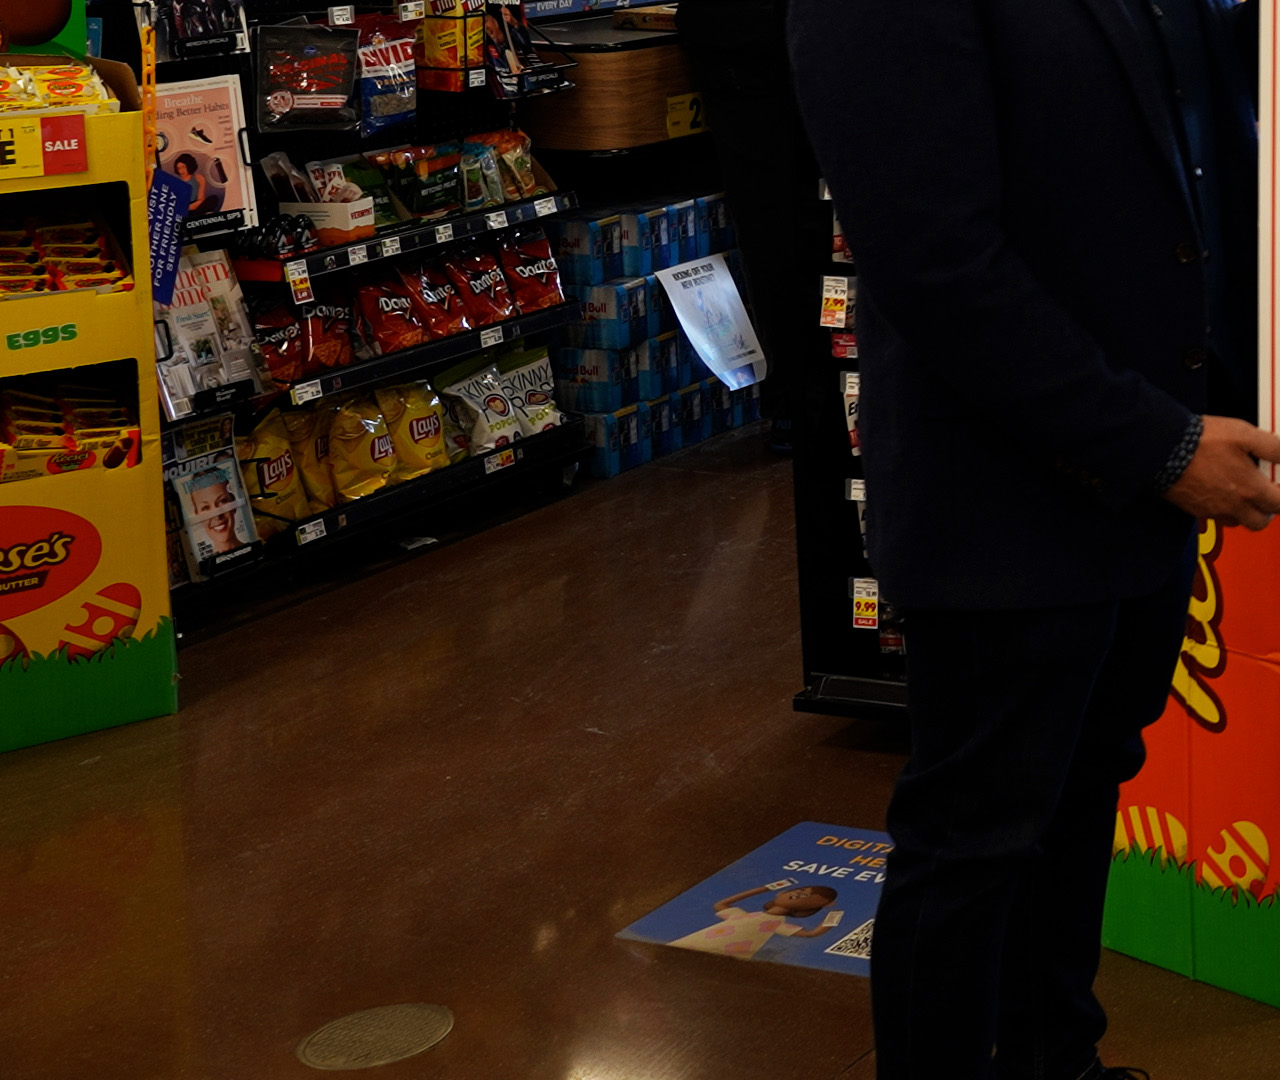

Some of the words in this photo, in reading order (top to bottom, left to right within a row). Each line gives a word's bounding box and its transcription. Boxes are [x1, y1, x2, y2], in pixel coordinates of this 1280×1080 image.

[536, 1, 558, 12] EVERY
[163, 93, 203, 109] Breathe
[176, 104, 203, 119] Better
[45, 138, 79, 152] SALE
[823, 297, 846, 310] 7.99
[6, 323, 78, 350] EGGS
[410, 413, 441, 441] Lay's
[263, 450, 295, 485] Lay's
[855, 601, 877, 614] 9.99
[782, 860, 855, 879] SAVE
